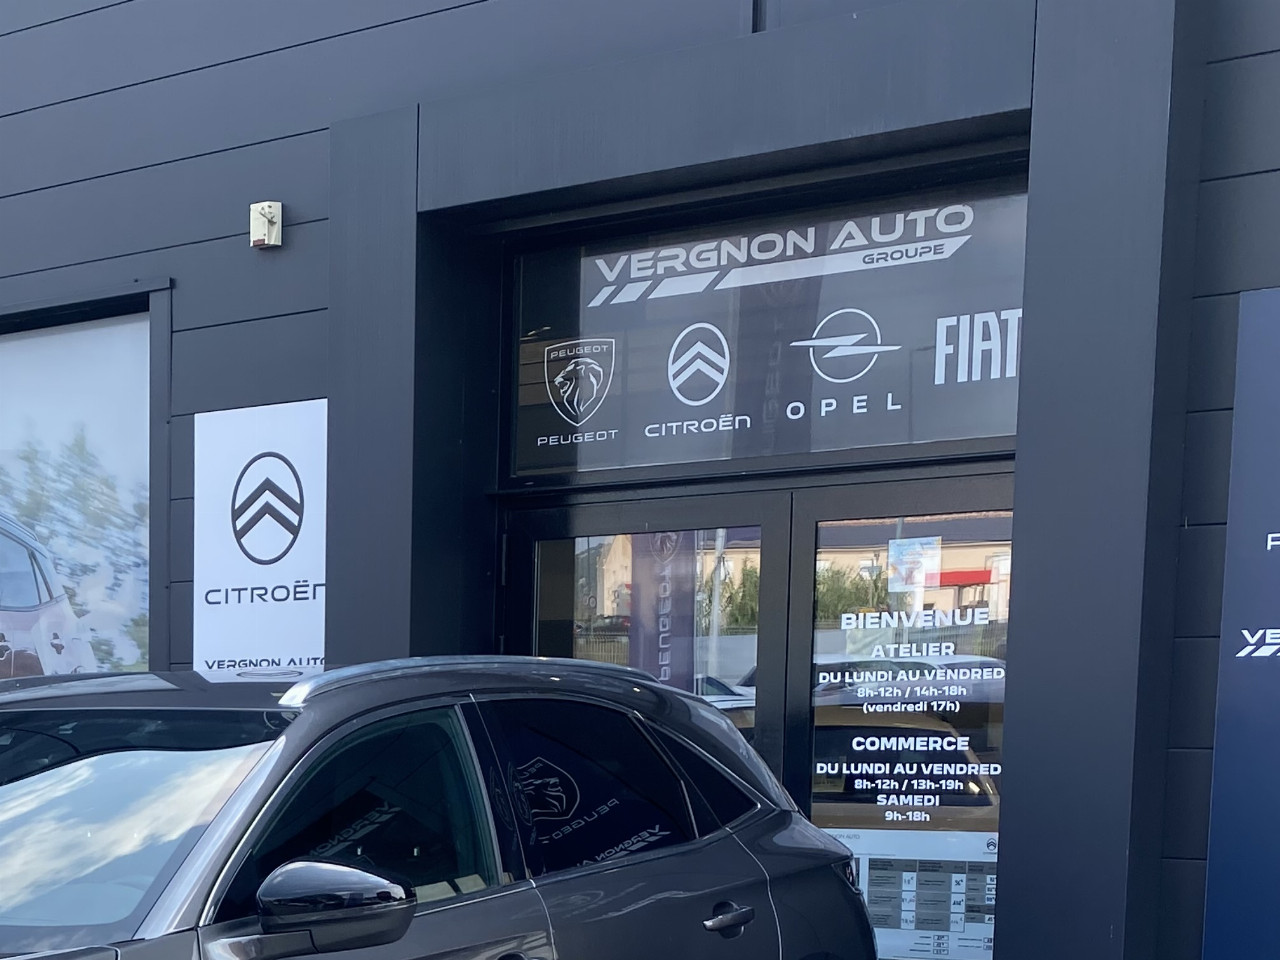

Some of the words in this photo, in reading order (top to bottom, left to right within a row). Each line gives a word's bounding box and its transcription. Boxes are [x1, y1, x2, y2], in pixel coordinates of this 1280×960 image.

[595, 226, 815, 282] VERGNON
[829, 204, 974, 250] AUTO
[862, 243, 945, 265] GROUPE
[550, 345, 609, 359] PEUGEOT
[934, 307, 1023, 385] FIAT
[786, 392, 902, 420] OPEL
[537, 429, 619, 446] PEUGEOT
[840, 607, 990, 630] BIENVENUE
[871, 642, 955, 659] ATELIER
[204, 658, 282, 670] VERGNON
[819, 671, 841, 684] DU
[845, 670, 892, 683] LUNDI
[896, 669, 919, 682] AU
[924, 668, 1006, 681] VENDRED
[856, 686, 902, 698] 8h-12h
[914, 685, 967, 697] 14h-18h
[862, 701, 928, 714] (vendredi
[931, 700, 961, 713] 17h)
[851, 736, 970, 751] COMMERCE
[816, 762, 839, 774] DU
[842, 762, 890, 775] LUNDI
[893, 763, 917, 775] AU
[921, 763, 1002, 775] VENDRED
[854, 779, 899, 790] 8h-12h
[911, 779, 964, 790] 13h-19h
[876, 794, 940, 806] SAMEDI
[884, 810, 930, 821] 9h-18h
